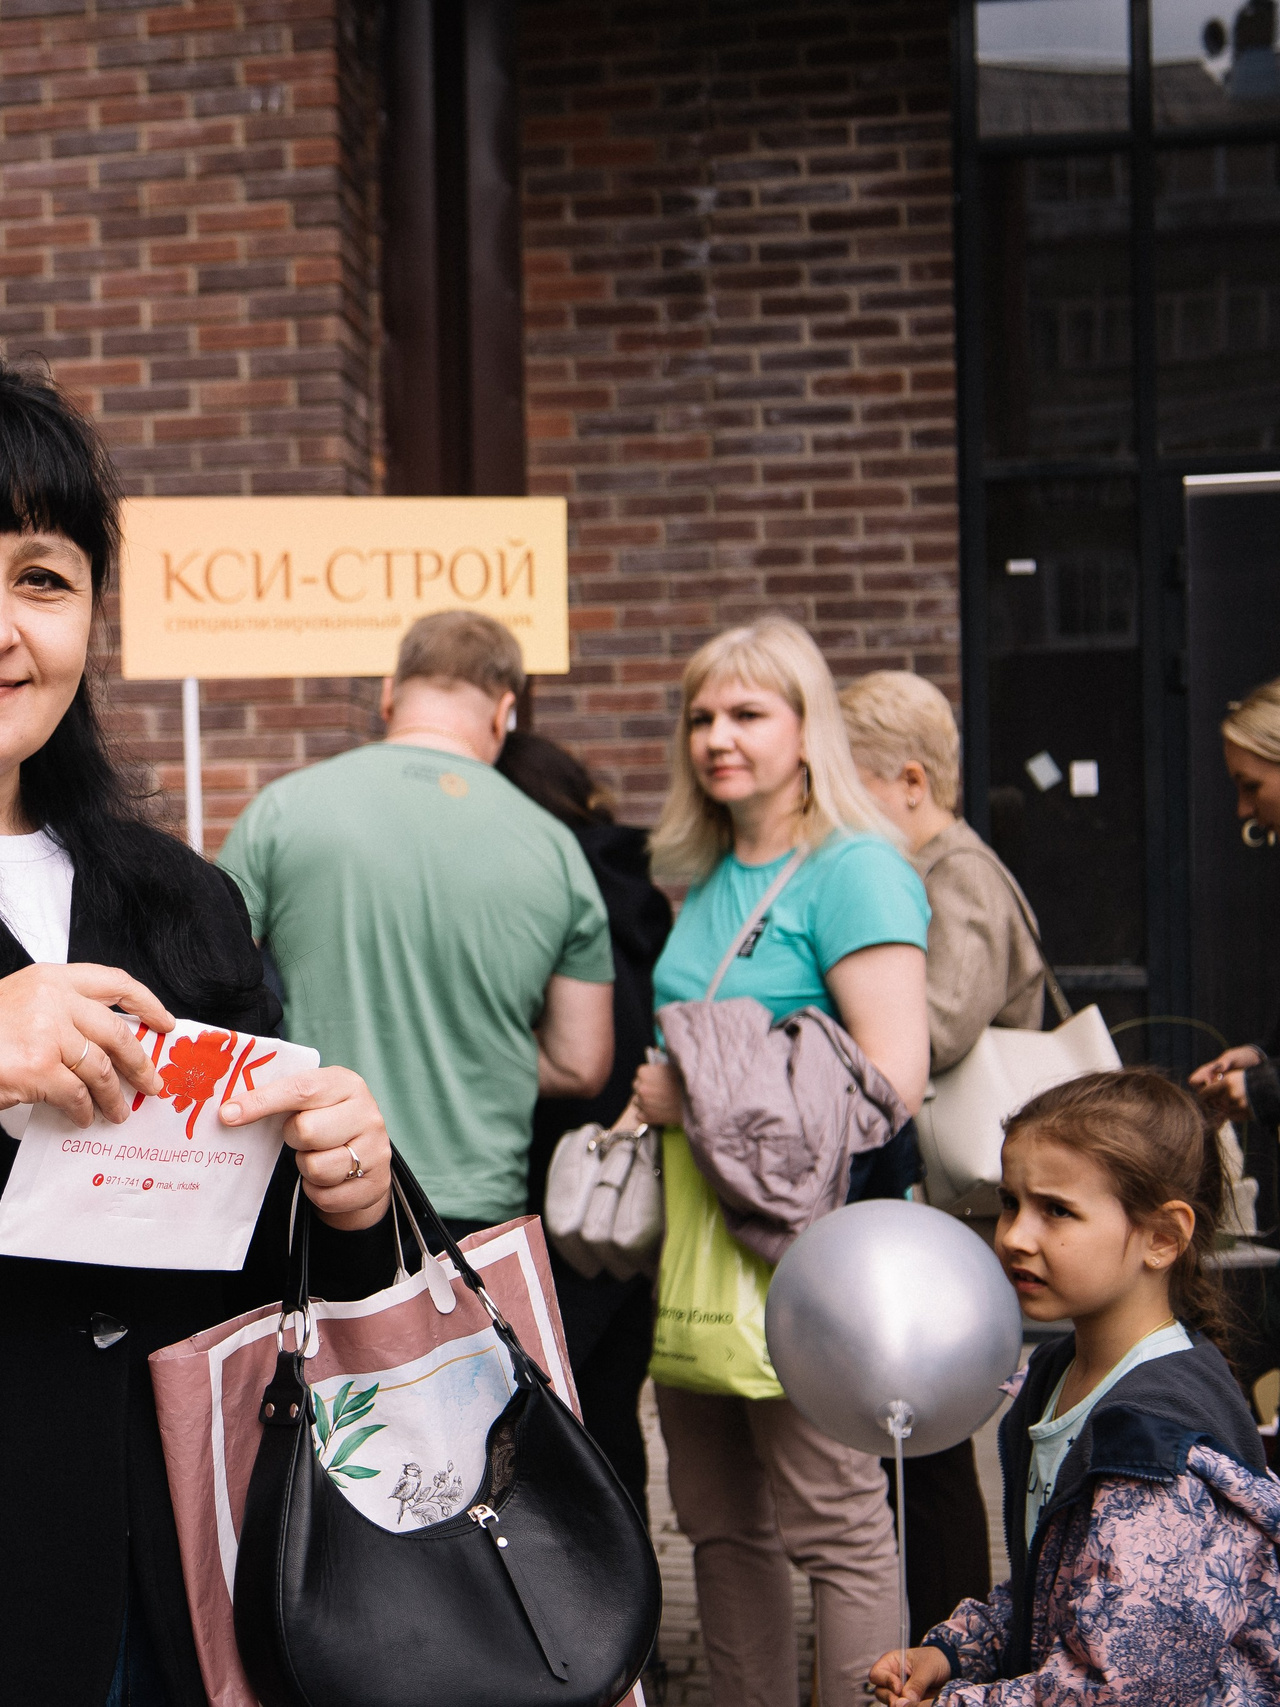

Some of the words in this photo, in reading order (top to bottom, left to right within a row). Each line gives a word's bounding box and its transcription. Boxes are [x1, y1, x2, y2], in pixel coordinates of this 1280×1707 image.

[160, 538, 536, 602] КСИ-СТРОЙ
[61, 1138, 113, 1156] салон
[114, 1145, 204, 1164] домашнего
[205, 1150, 246, 1167] уюта
[105, 1175, 140, 1187] 971-741
[155, 1181, 201, 1191] mak_irkutsk
